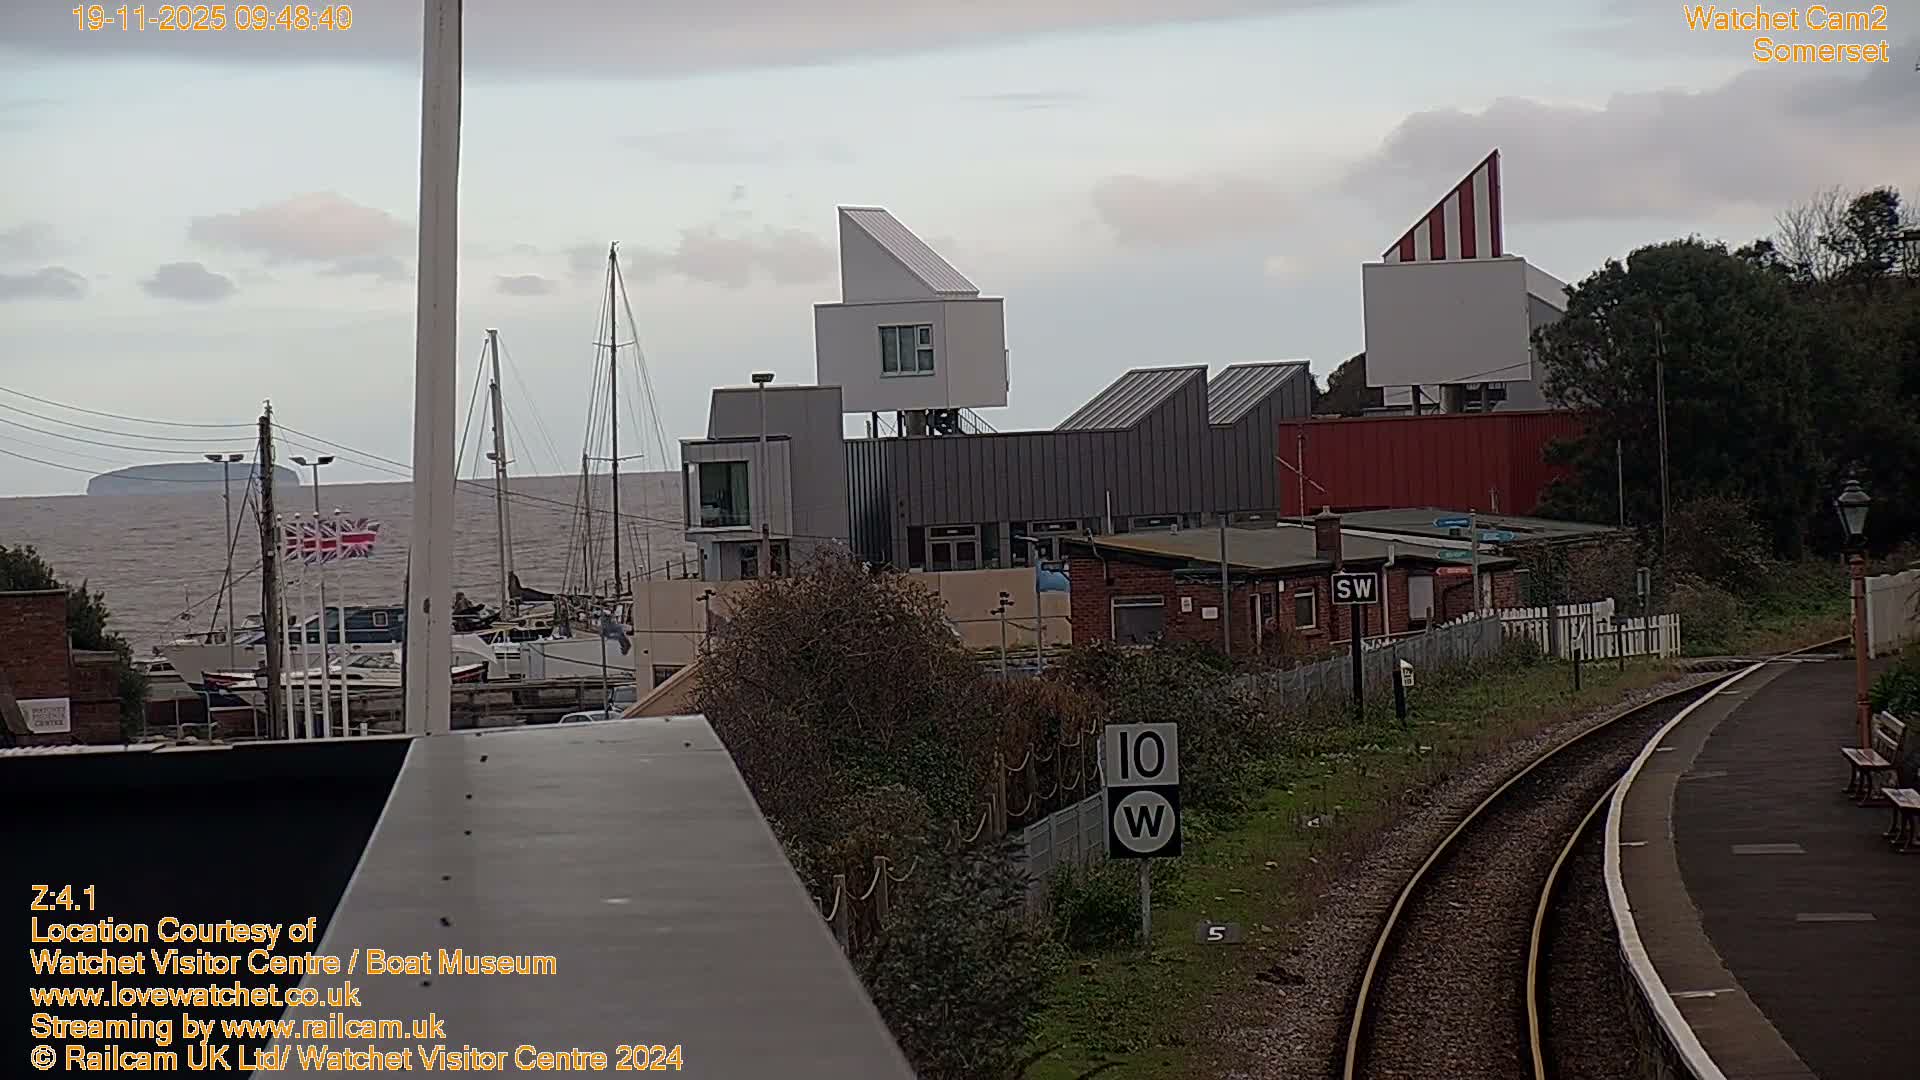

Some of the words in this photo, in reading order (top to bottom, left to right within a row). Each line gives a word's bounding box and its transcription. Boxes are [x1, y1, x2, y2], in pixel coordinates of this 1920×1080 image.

[1337, 579, 1371, 598] SW
[1119, 730, 1165, 779] 10
[1122, 805, 1165, 838] W
[1207, 926, 1226, 941] 5
